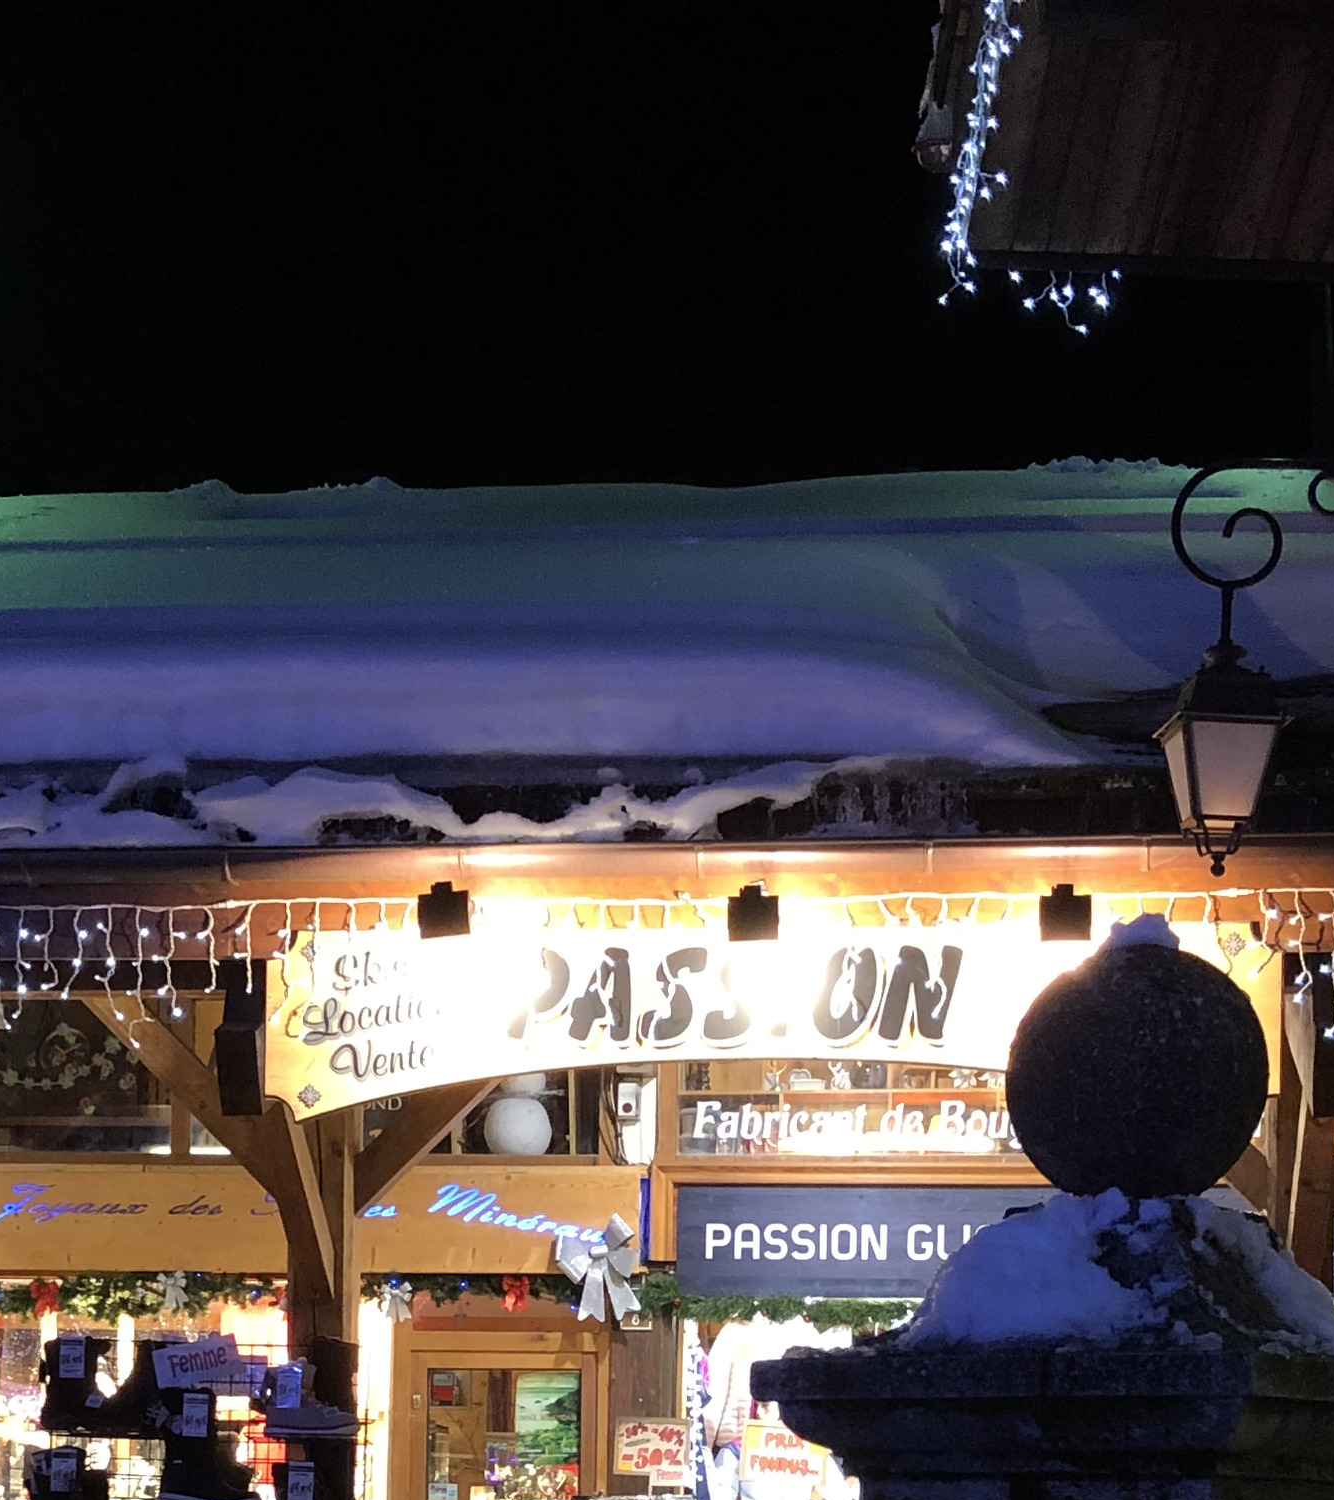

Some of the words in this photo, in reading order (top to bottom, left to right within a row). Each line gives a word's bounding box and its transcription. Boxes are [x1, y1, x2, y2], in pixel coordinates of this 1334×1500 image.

[693, 1101, 867, 1141] Fabricant
[880, 1102, 924, 1138] de
[168, 1195, 223, 1216] des
[705, 1223, 888, 1261] PASSION
[168, 1346, 227, 1378] Femme
